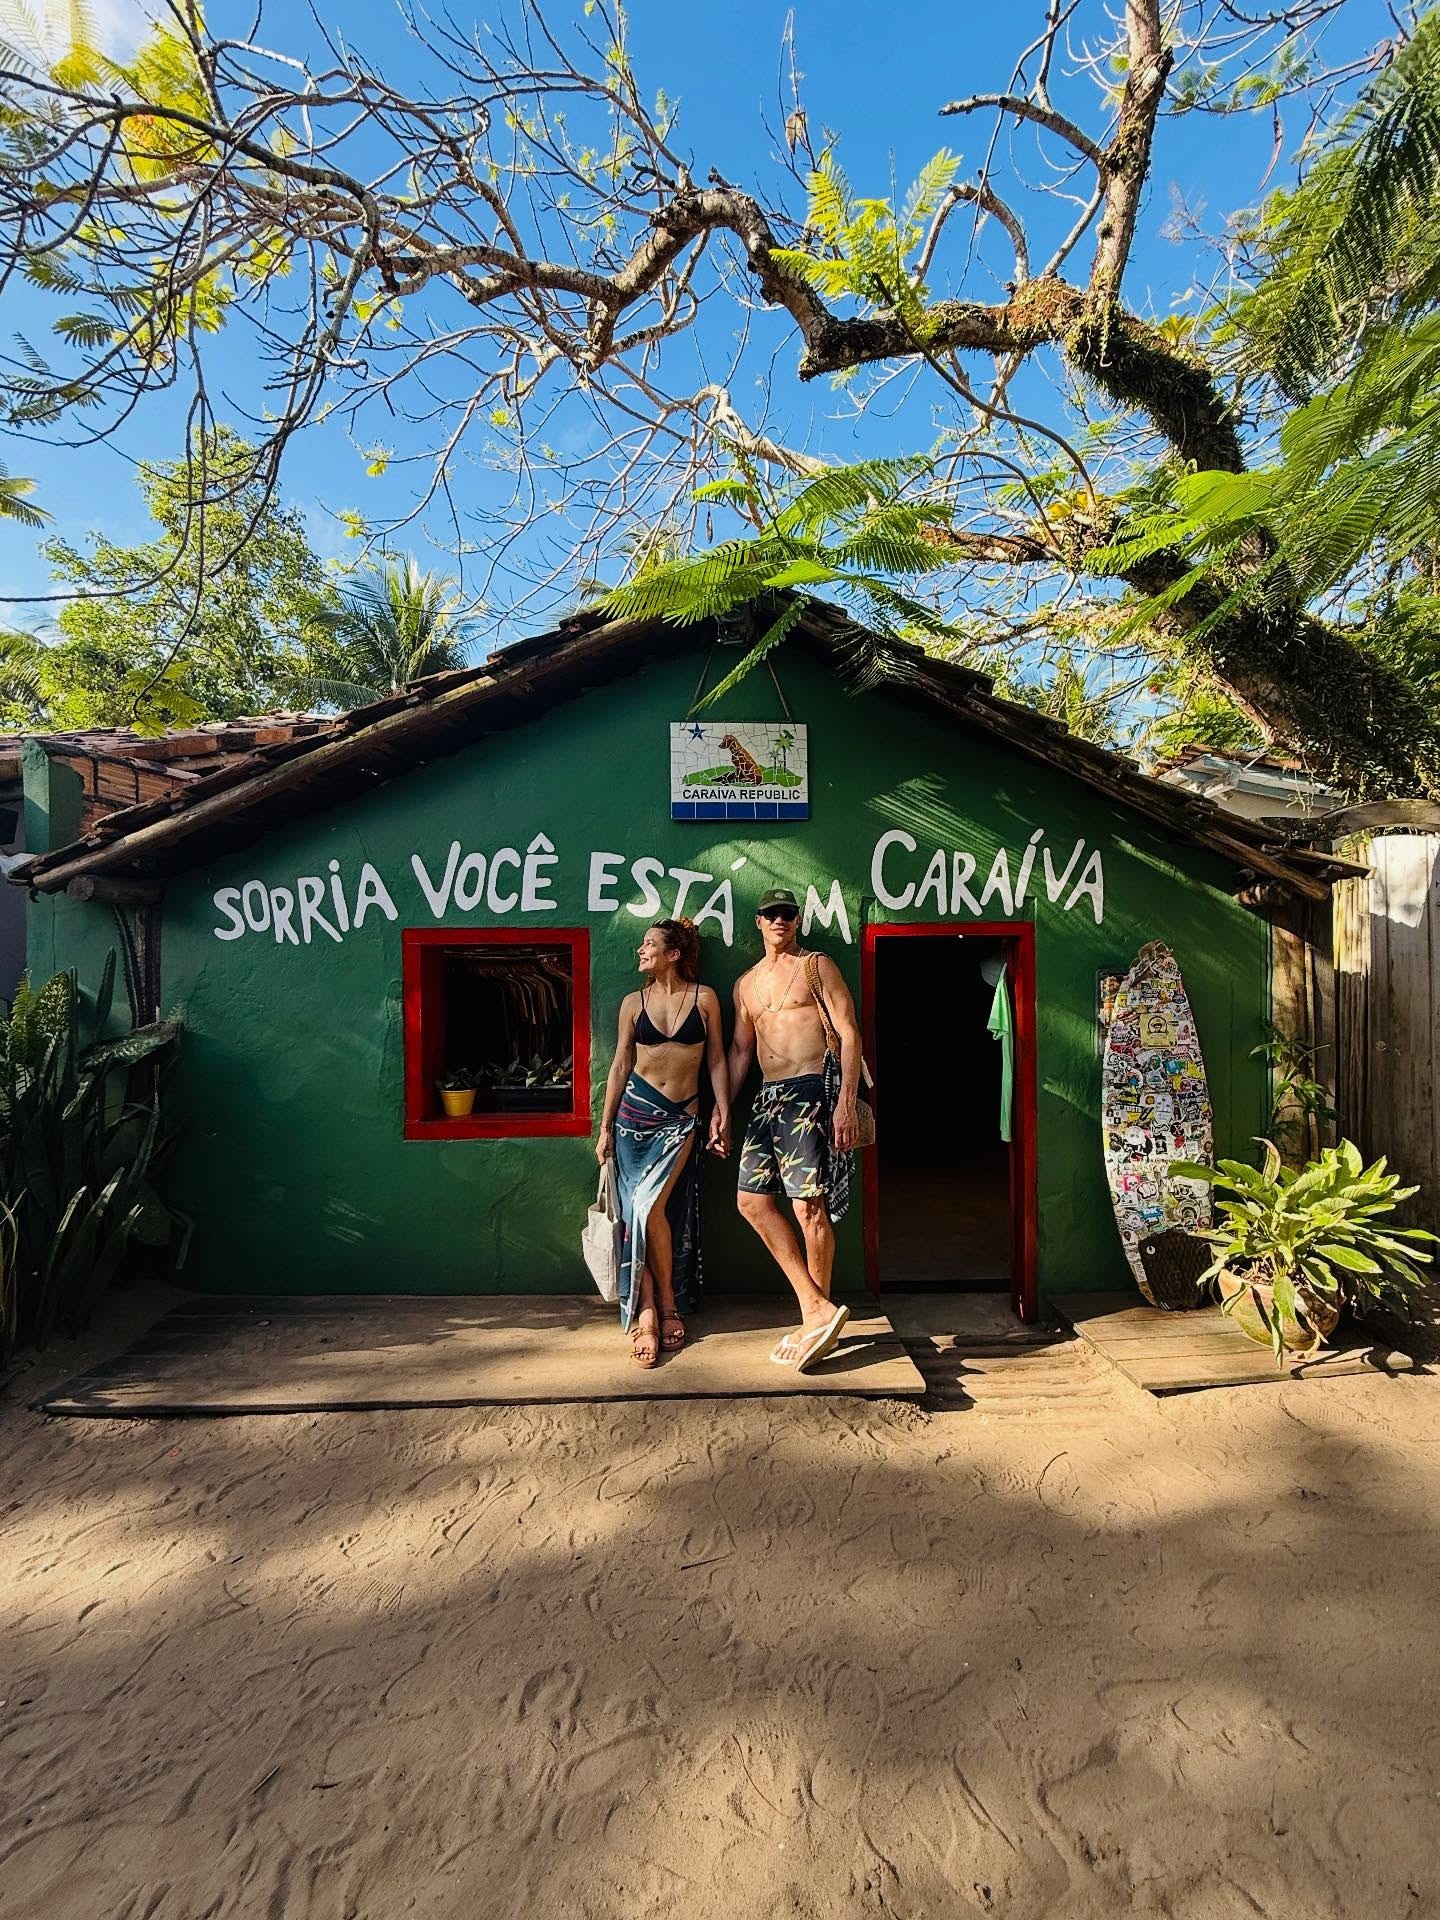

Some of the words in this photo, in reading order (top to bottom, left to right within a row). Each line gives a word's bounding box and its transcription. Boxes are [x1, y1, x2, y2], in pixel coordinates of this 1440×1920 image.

[739, 789, 801, 800] REPUBLIC
[411, 832, 559, 919] VOCÊ
[587, 851, 748, 947] ESTÁ
[870, 828, 1104, 925] CARAÍVA
